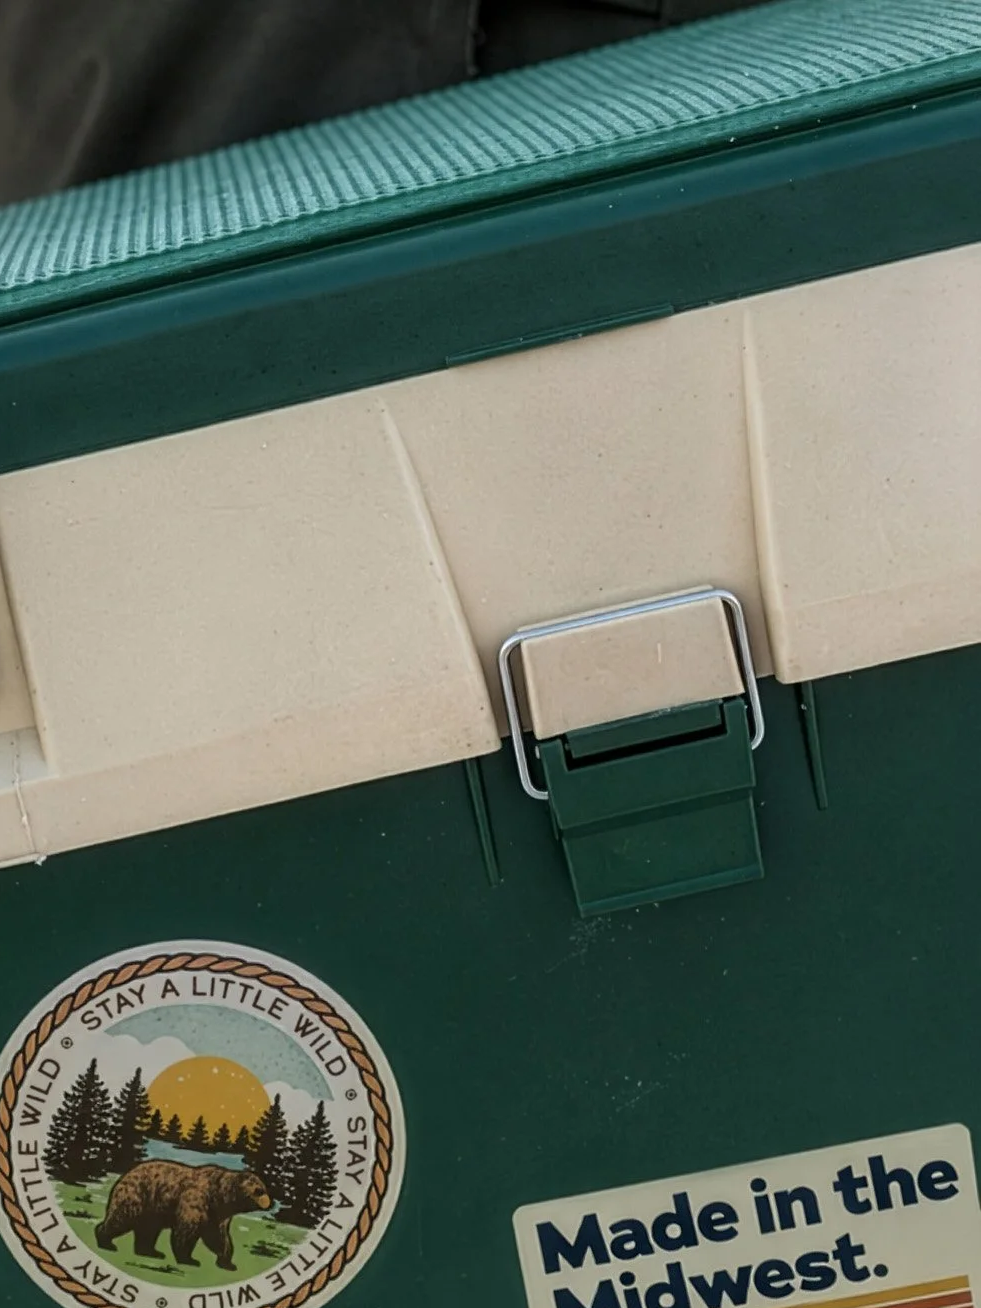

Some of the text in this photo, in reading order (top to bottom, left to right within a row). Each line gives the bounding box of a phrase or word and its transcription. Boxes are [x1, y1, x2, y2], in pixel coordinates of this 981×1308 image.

[81, 976, 348, 1078] STAY A LITTLE WILD
[18, 1057, 139, 1303] STAY A LITTLE WILD
[346, 1115, 367, 1186] STAY
[333, 1191, 354, 1209] A
[536, 1154, 959, 1275] Made in the
[269, 1216, 343, 1292] LITTLE
